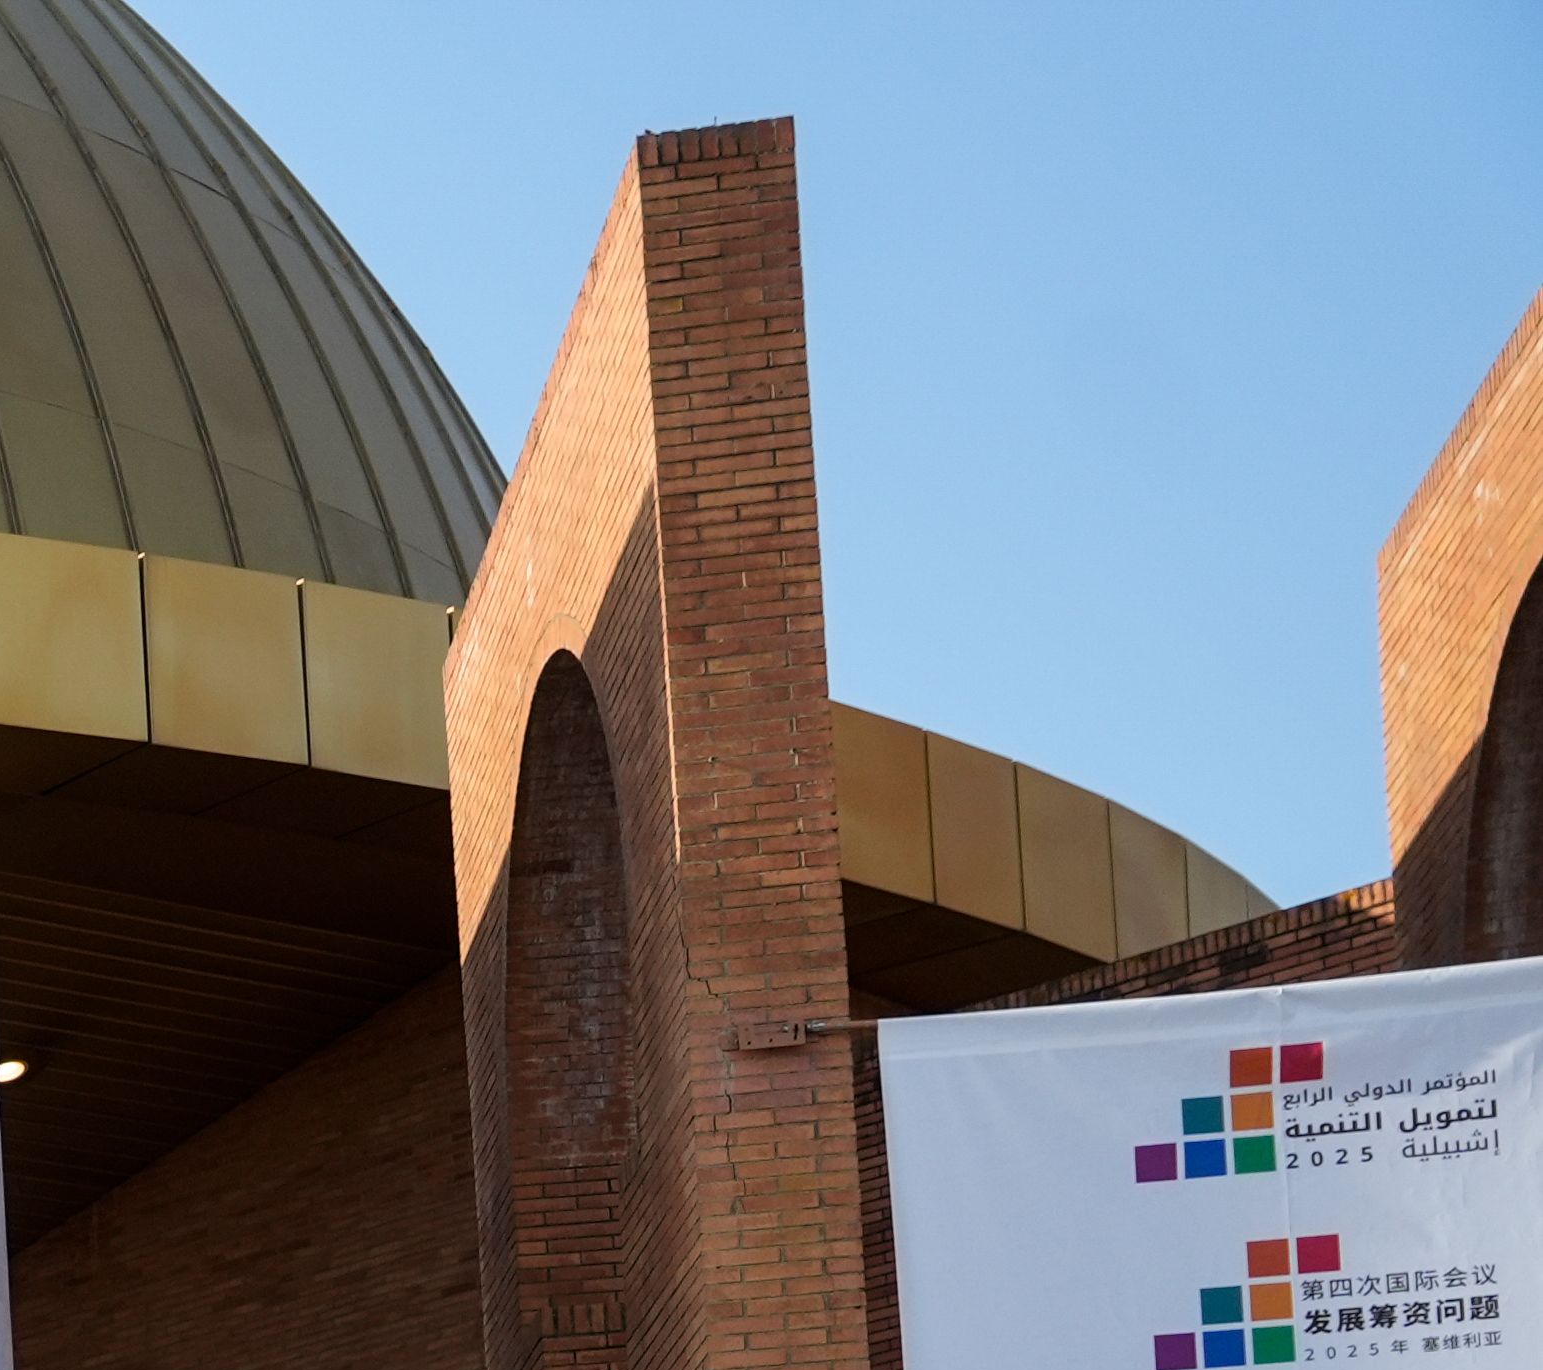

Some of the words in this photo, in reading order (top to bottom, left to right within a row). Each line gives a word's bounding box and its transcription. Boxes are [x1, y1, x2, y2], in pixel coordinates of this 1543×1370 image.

[1282, 1086, 1333, 1110] الرابع
[1343, 1078, 1412, 1108] الدولي
[1421, 1069, 1497, 1095] المؤتمر
[1285, 1111, 1383, 1143] التنمية
[1398, 1098, 1499, 1134] لتمويل
[1285, 1146, 1375, 1170] 2025
[1401, 1128, 1501, 1162] إشبيلية
[1301, 1263, 1497, 1301] 第四次国际会议
[1303, 1294, 1501, 1335] 发展筹资问题
